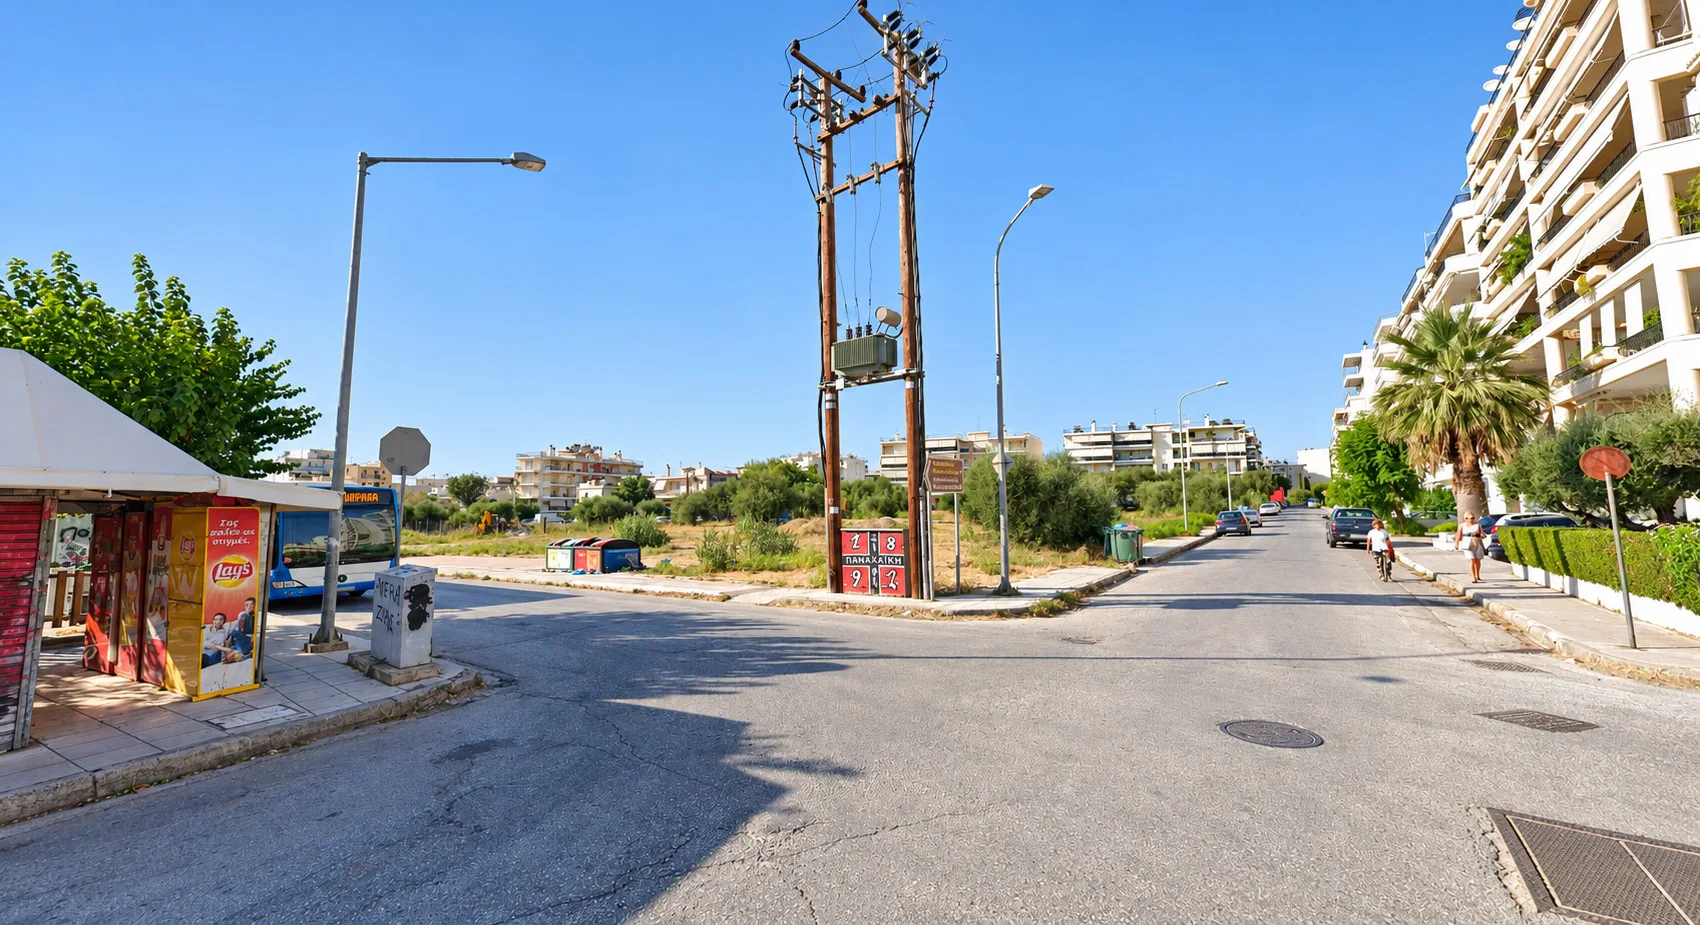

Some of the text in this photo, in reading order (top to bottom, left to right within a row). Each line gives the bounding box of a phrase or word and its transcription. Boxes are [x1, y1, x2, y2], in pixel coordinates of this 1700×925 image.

[886, 536, 896, 551] 8
[852, 570, 861, 588] 9
[378, 577, 401, 607] VERA
